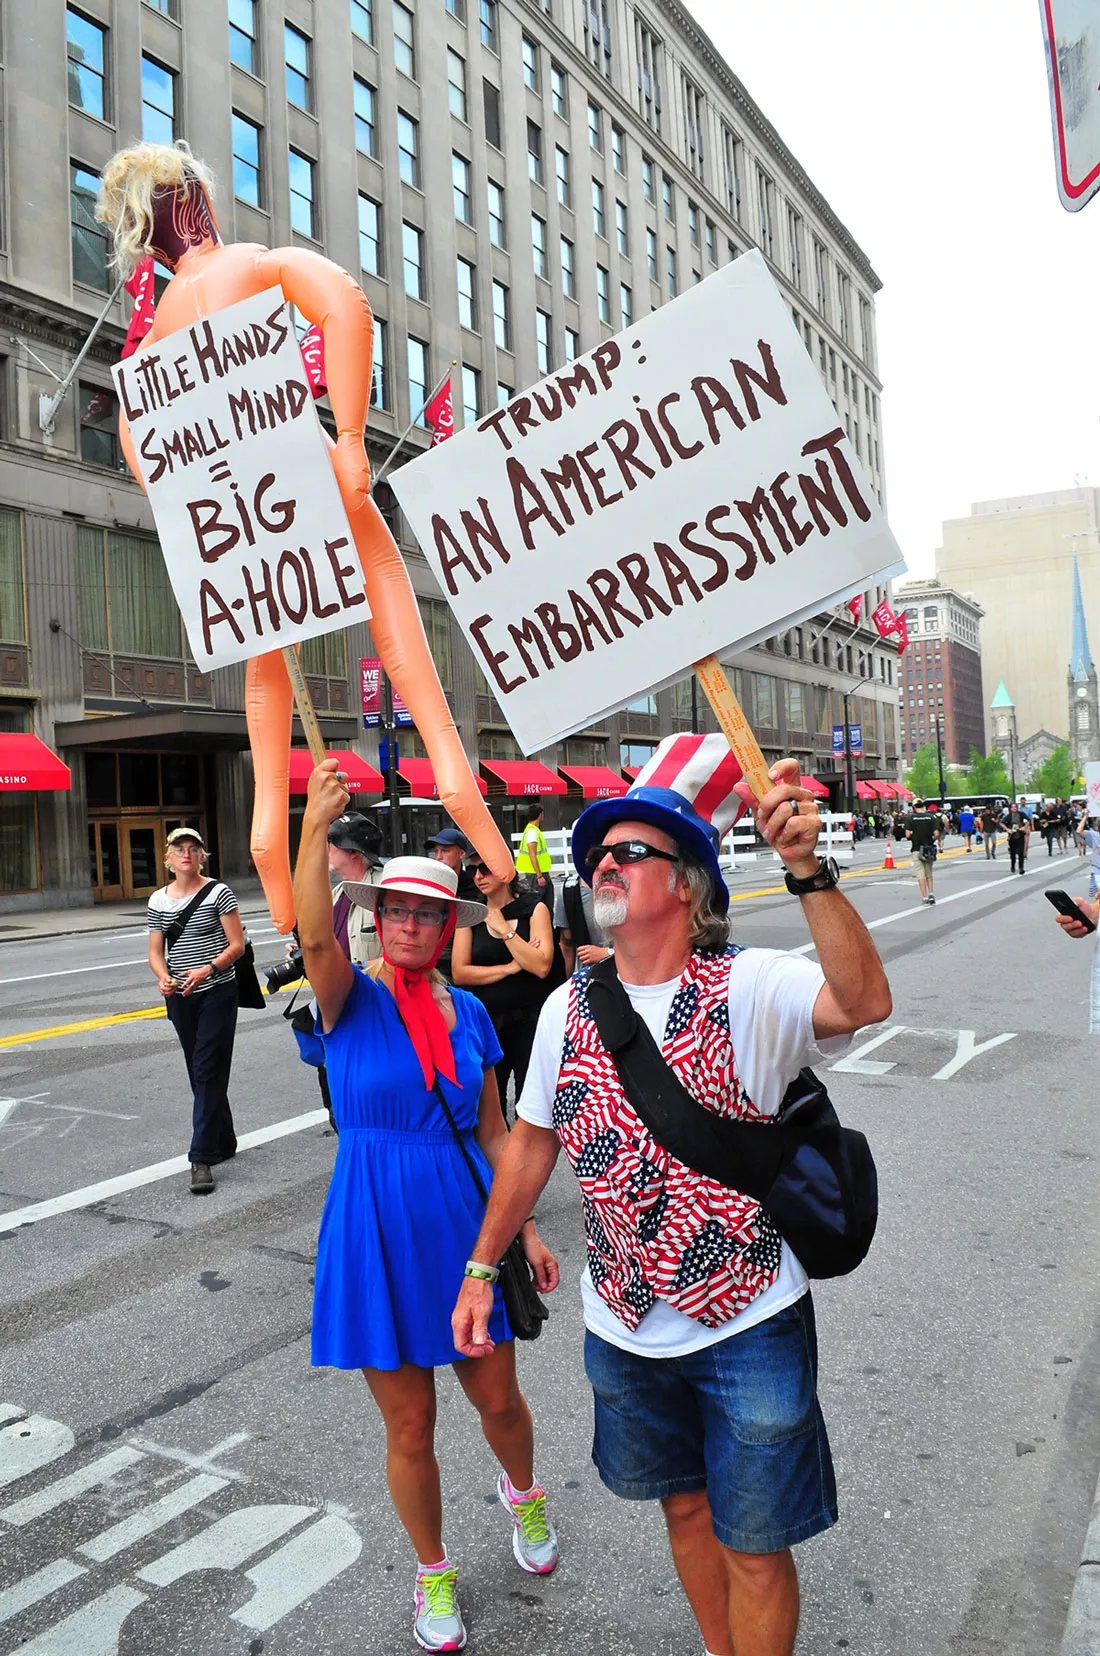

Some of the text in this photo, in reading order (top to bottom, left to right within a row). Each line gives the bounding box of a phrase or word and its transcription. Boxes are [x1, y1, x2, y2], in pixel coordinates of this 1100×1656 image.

[190, 304, 289, 384] HANDS
[477, 340, 648, 450] TRUMP:
[141, 418, 230, 484] SMALL
[431, 497, 511, 596] AN
[470, 426, 872, 694] EMBARRASSMENT
[200, 538, 365, 655] A-HOLE
[363, 669, 379, 680] WE
[0, 776, 28, 784] ASINO
[524, 784, 540, 793] JACK
